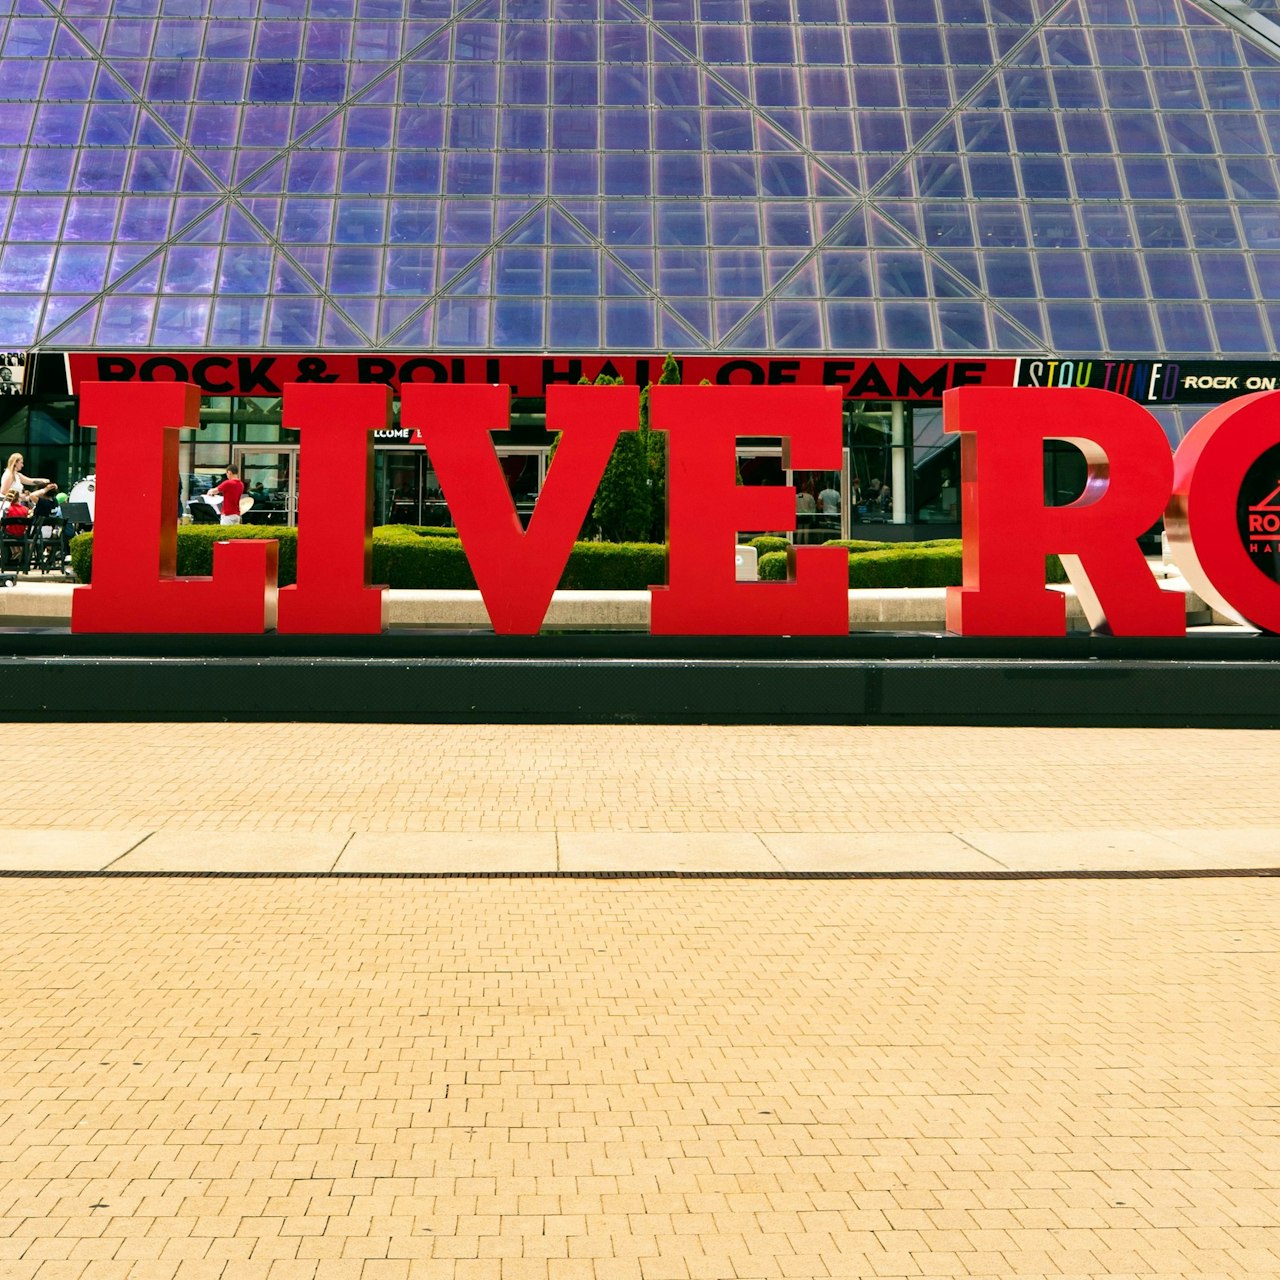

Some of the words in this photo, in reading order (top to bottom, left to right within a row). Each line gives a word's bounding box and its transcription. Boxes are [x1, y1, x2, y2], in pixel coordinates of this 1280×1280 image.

[96, 356, 285, 394] ROCK
[296, 356, 340, 383] &
[715, 359, 801, 387] OF
[822, 360, 987, 398] FAME
[1182, 375, 1239, 390] ROCK
[1245, 376, 1277, 390] ON
[373, 428, 409, 438] LCOME
[71, 380, 849, 636] LIVE
